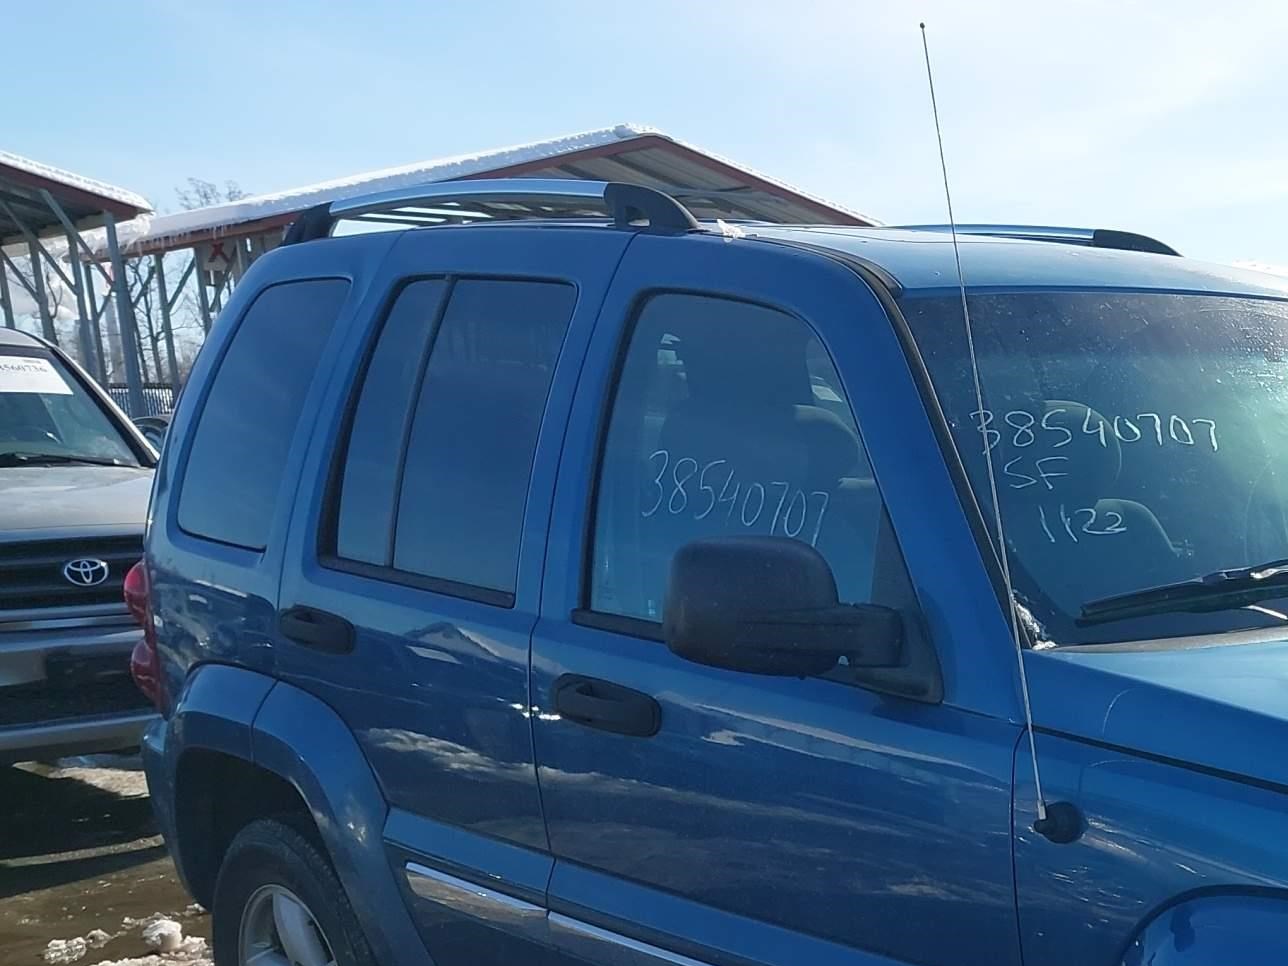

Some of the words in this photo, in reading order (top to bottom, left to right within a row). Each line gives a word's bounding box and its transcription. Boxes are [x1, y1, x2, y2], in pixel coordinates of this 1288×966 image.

[969, 408, 1218, 454] 38540707
[1003, 456, 1070, 489] SF
[641, 450, 829, 548] 38540707
[1038, 504, 1128, 543] 1122
